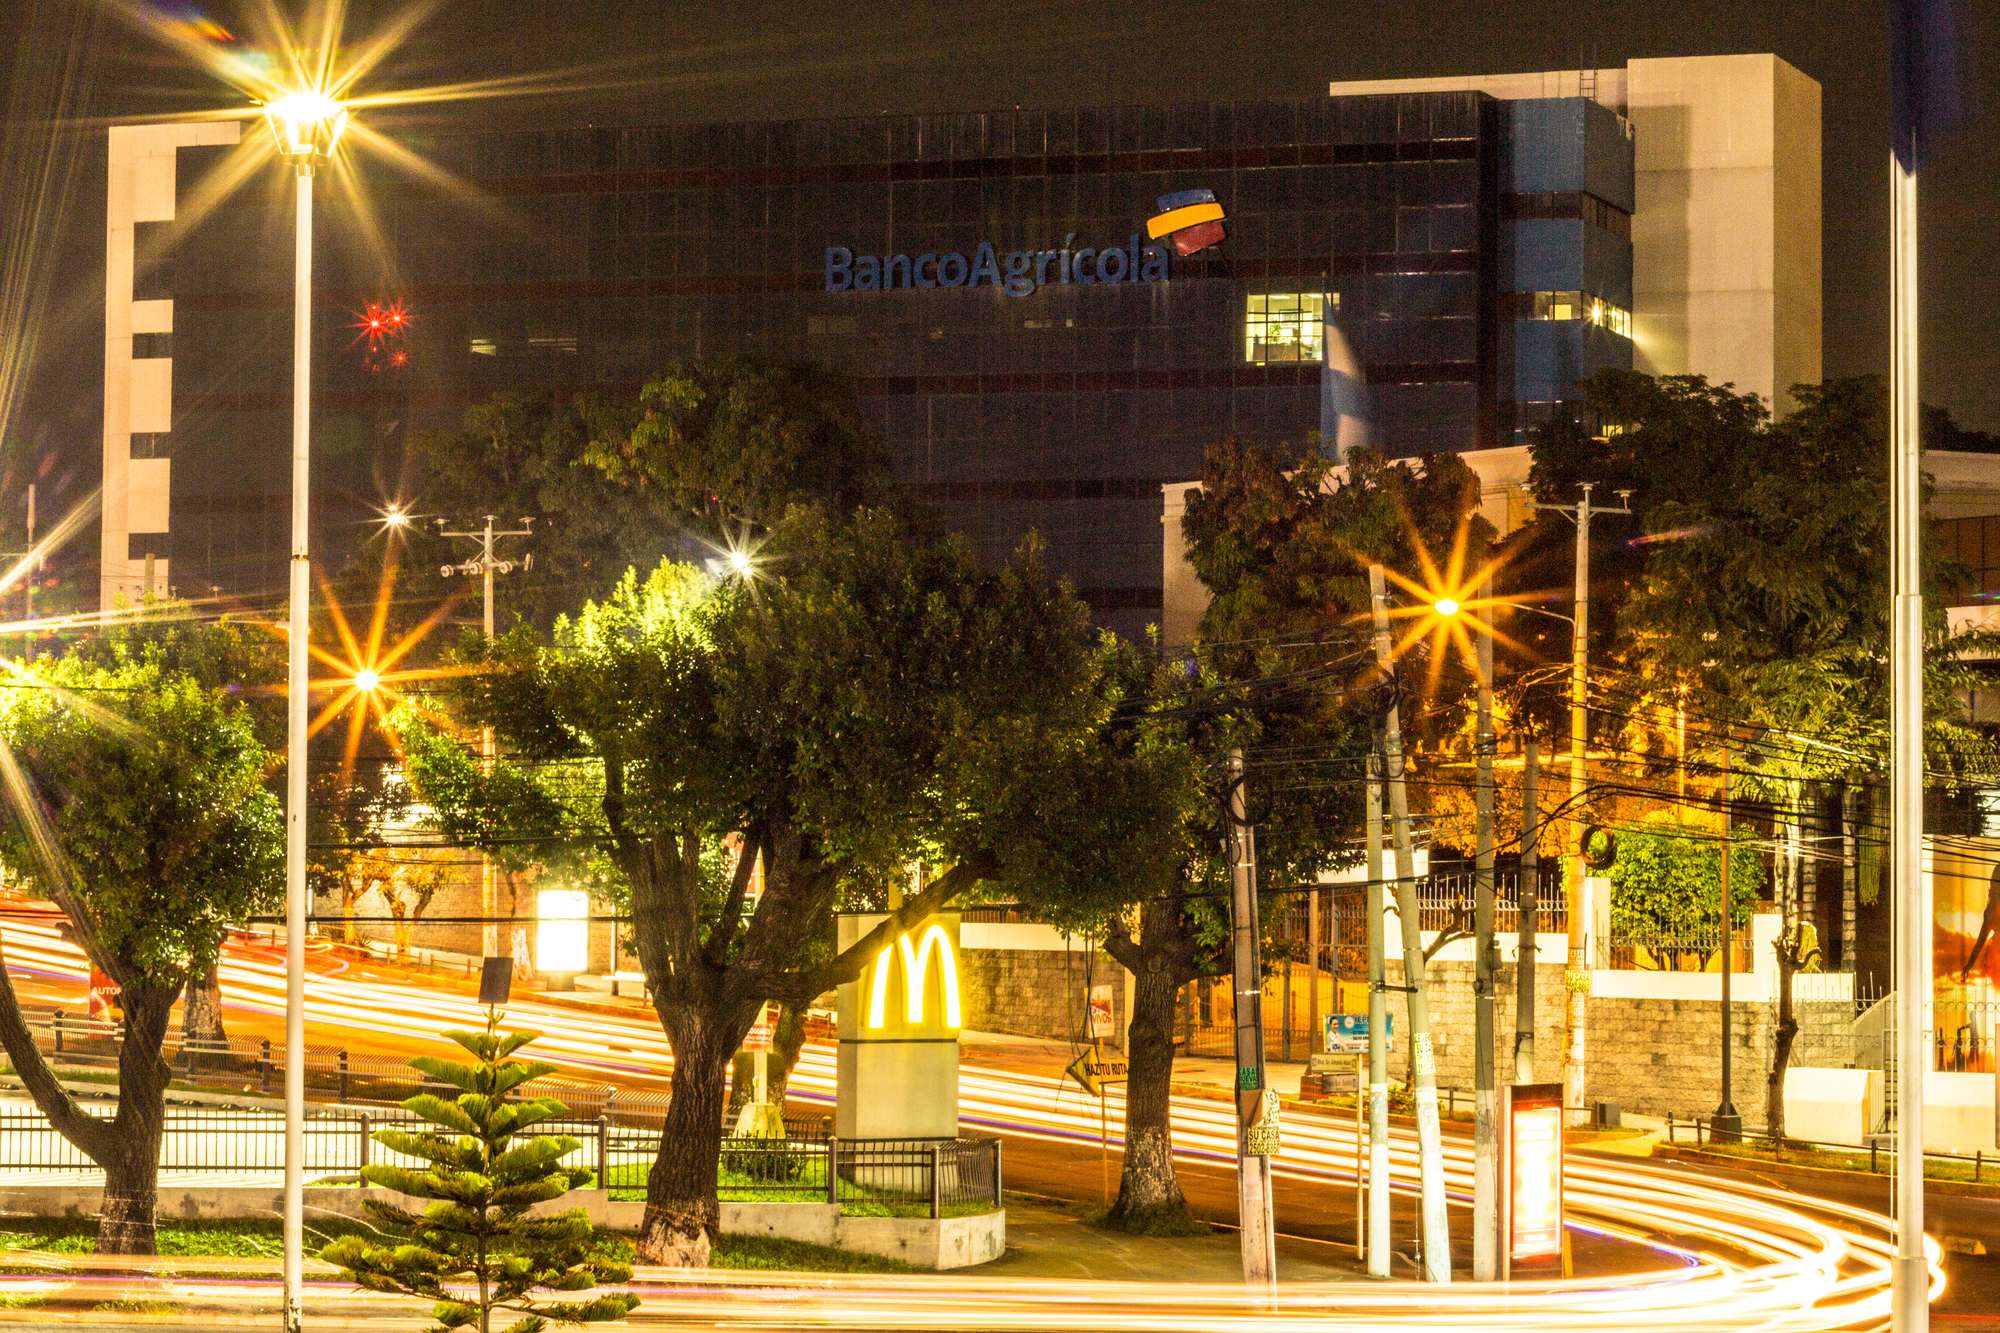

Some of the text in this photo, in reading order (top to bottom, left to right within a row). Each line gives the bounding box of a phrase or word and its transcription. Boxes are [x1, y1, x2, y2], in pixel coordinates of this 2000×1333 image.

[822, 232, 1170, 298] BancoAgrícola
[1084, 1062, 1129, 1076] HAZ TU RUTA
[1248, 1129, 1279, 1140] SU CASA
